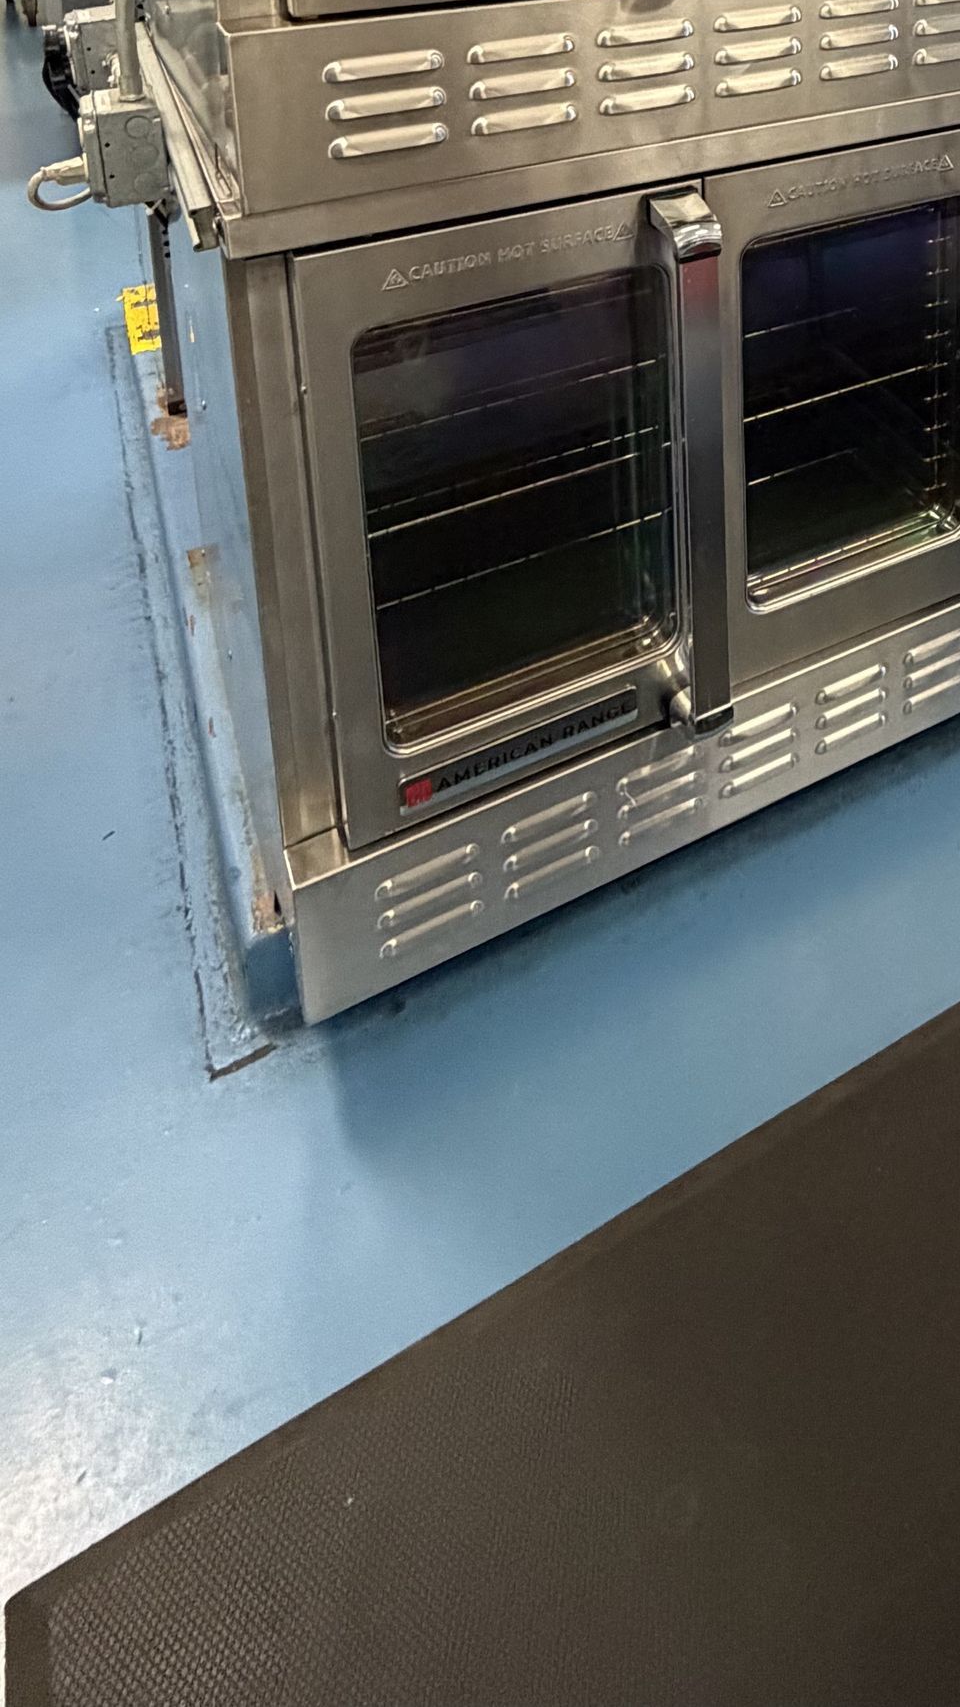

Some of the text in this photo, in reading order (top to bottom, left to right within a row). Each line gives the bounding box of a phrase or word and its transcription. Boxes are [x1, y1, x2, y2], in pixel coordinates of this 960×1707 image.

[408, 225, 615, 282] CAUTION HOT SURFACE
[436, 697, 637, 793] AMERICAN RANGE
